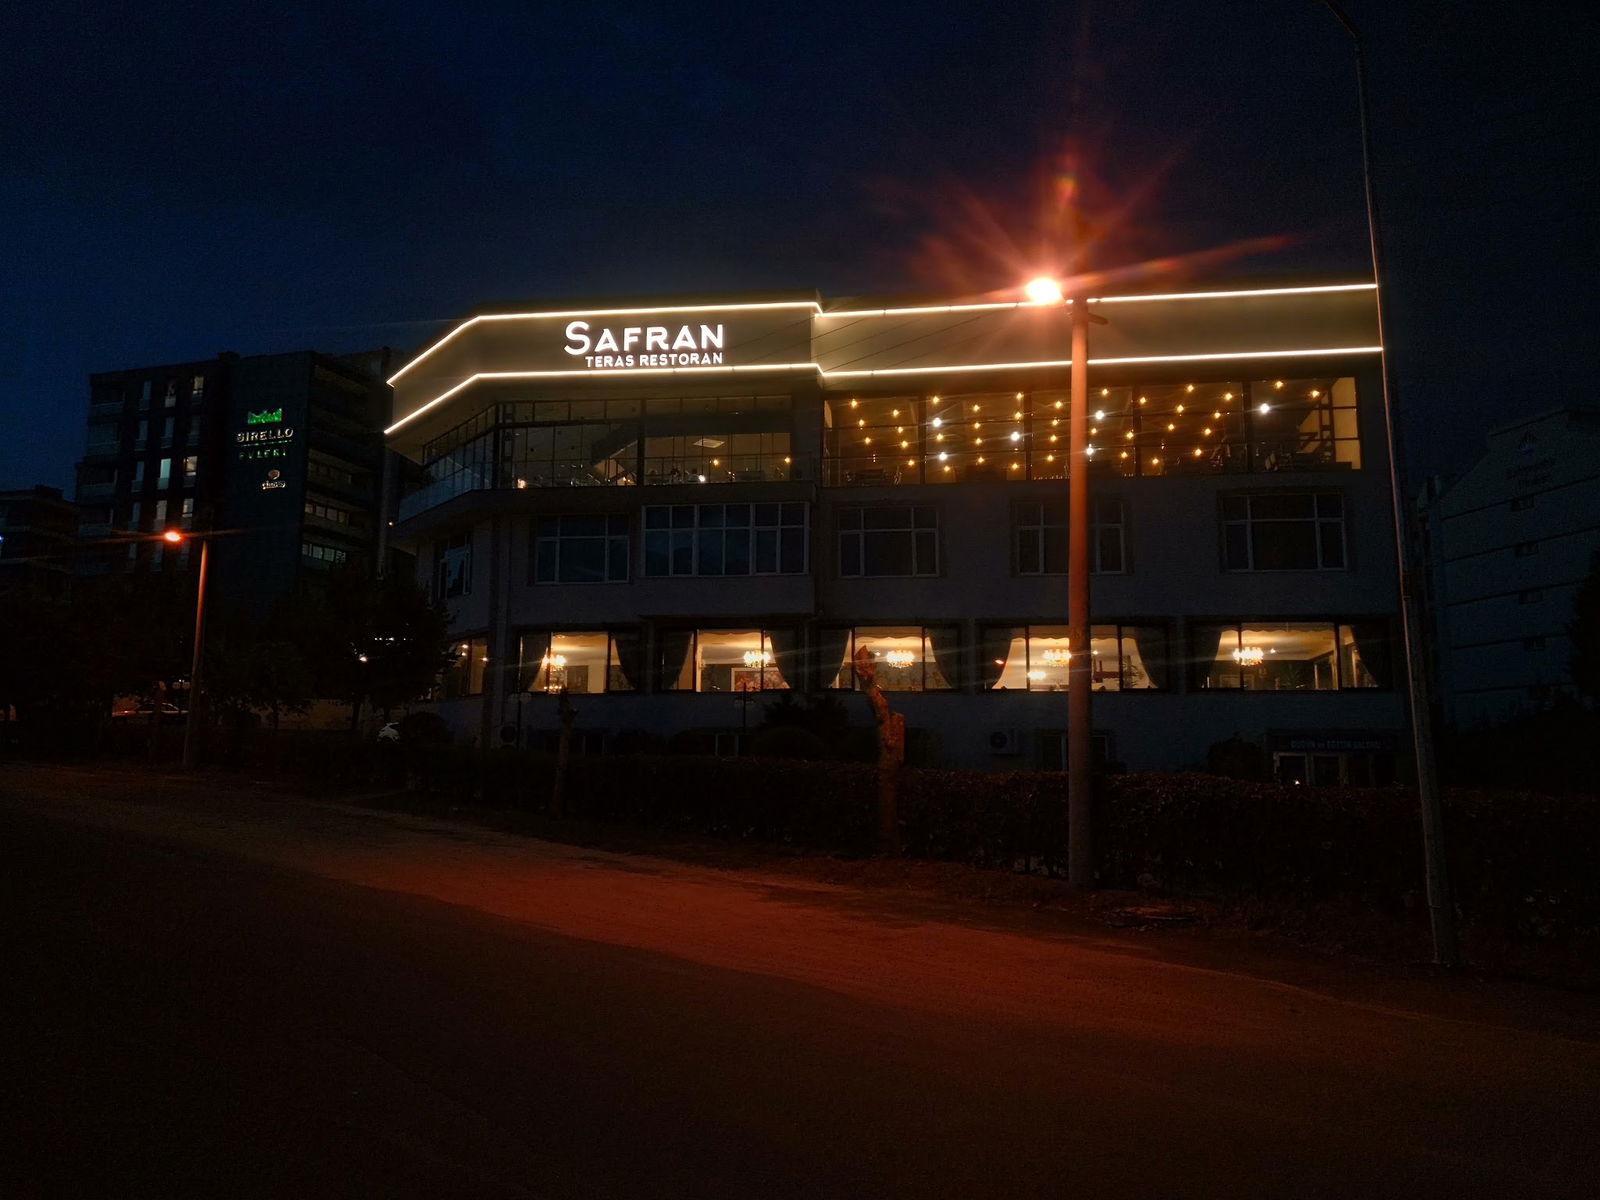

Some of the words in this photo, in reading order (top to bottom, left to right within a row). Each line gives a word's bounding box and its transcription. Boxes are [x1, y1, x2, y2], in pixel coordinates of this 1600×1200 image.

[564, 321, 725, 355] SAFRAN
[585, 356, 635, 368] TERAS
[639, 353, 724, 367] RESTORAN
